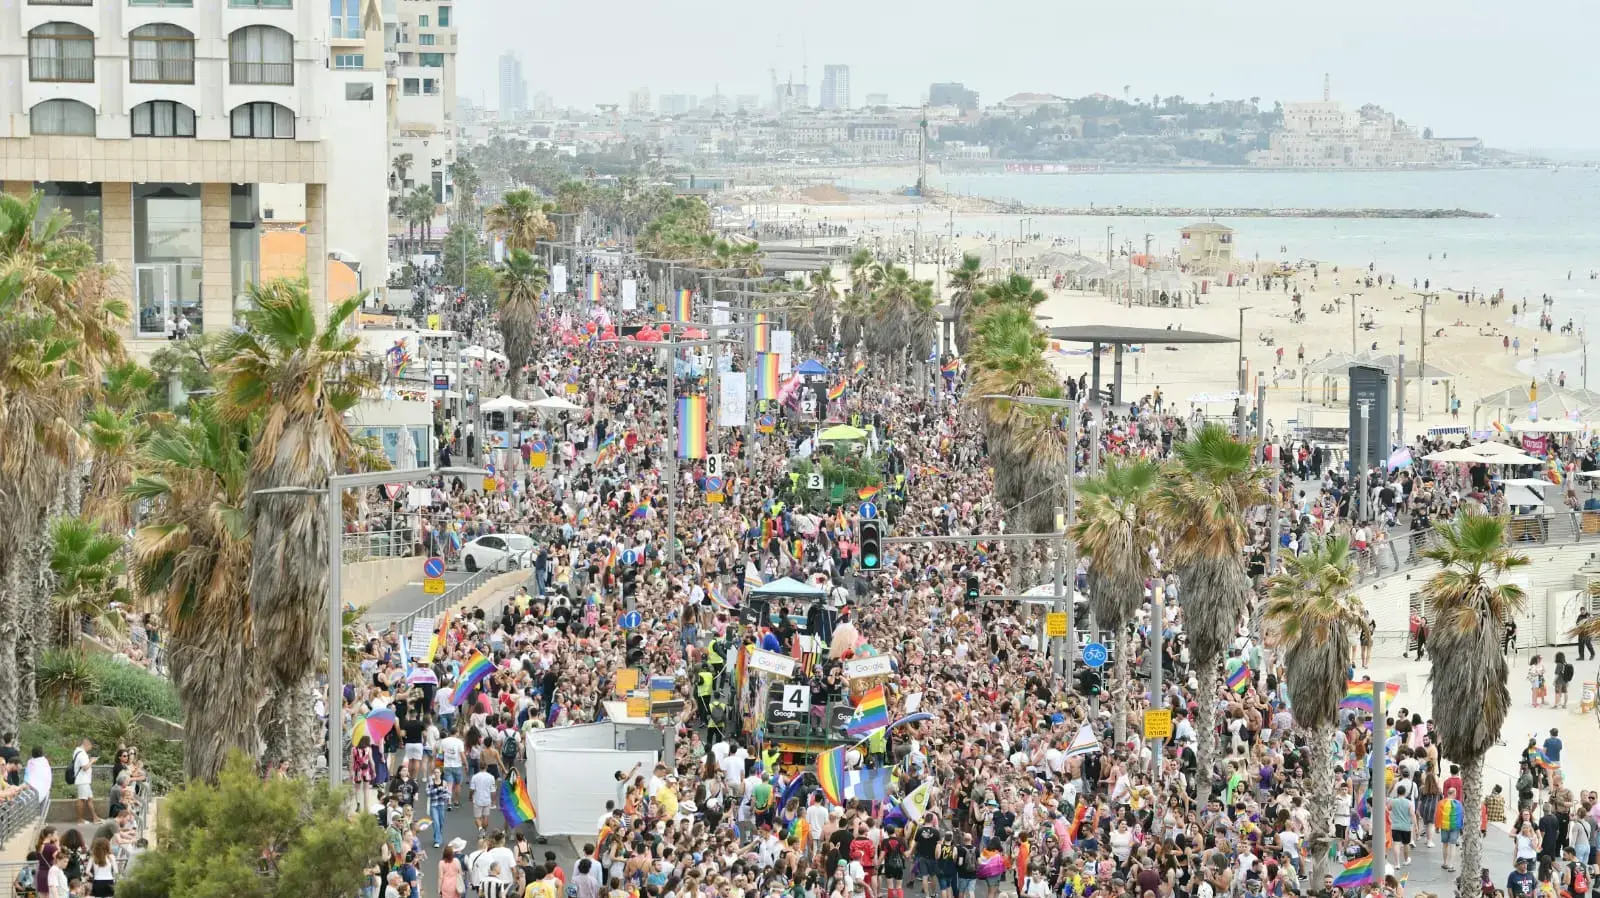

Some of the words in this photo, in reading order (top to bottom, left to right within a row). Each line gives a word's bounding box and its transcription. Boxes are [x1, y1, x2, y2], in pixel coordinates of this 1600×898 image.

[707, 356, 713, 368] 7
[805, 402, 812, 412] 2
[708, 456, 717, 474] 8
[811, 475, 820, 487] 3
[758, 656, 787, 672] Google
[855, 659, 884, 673] Google
[789, 689, 803, 708] 4
[773, 709, 796, 719] Google
